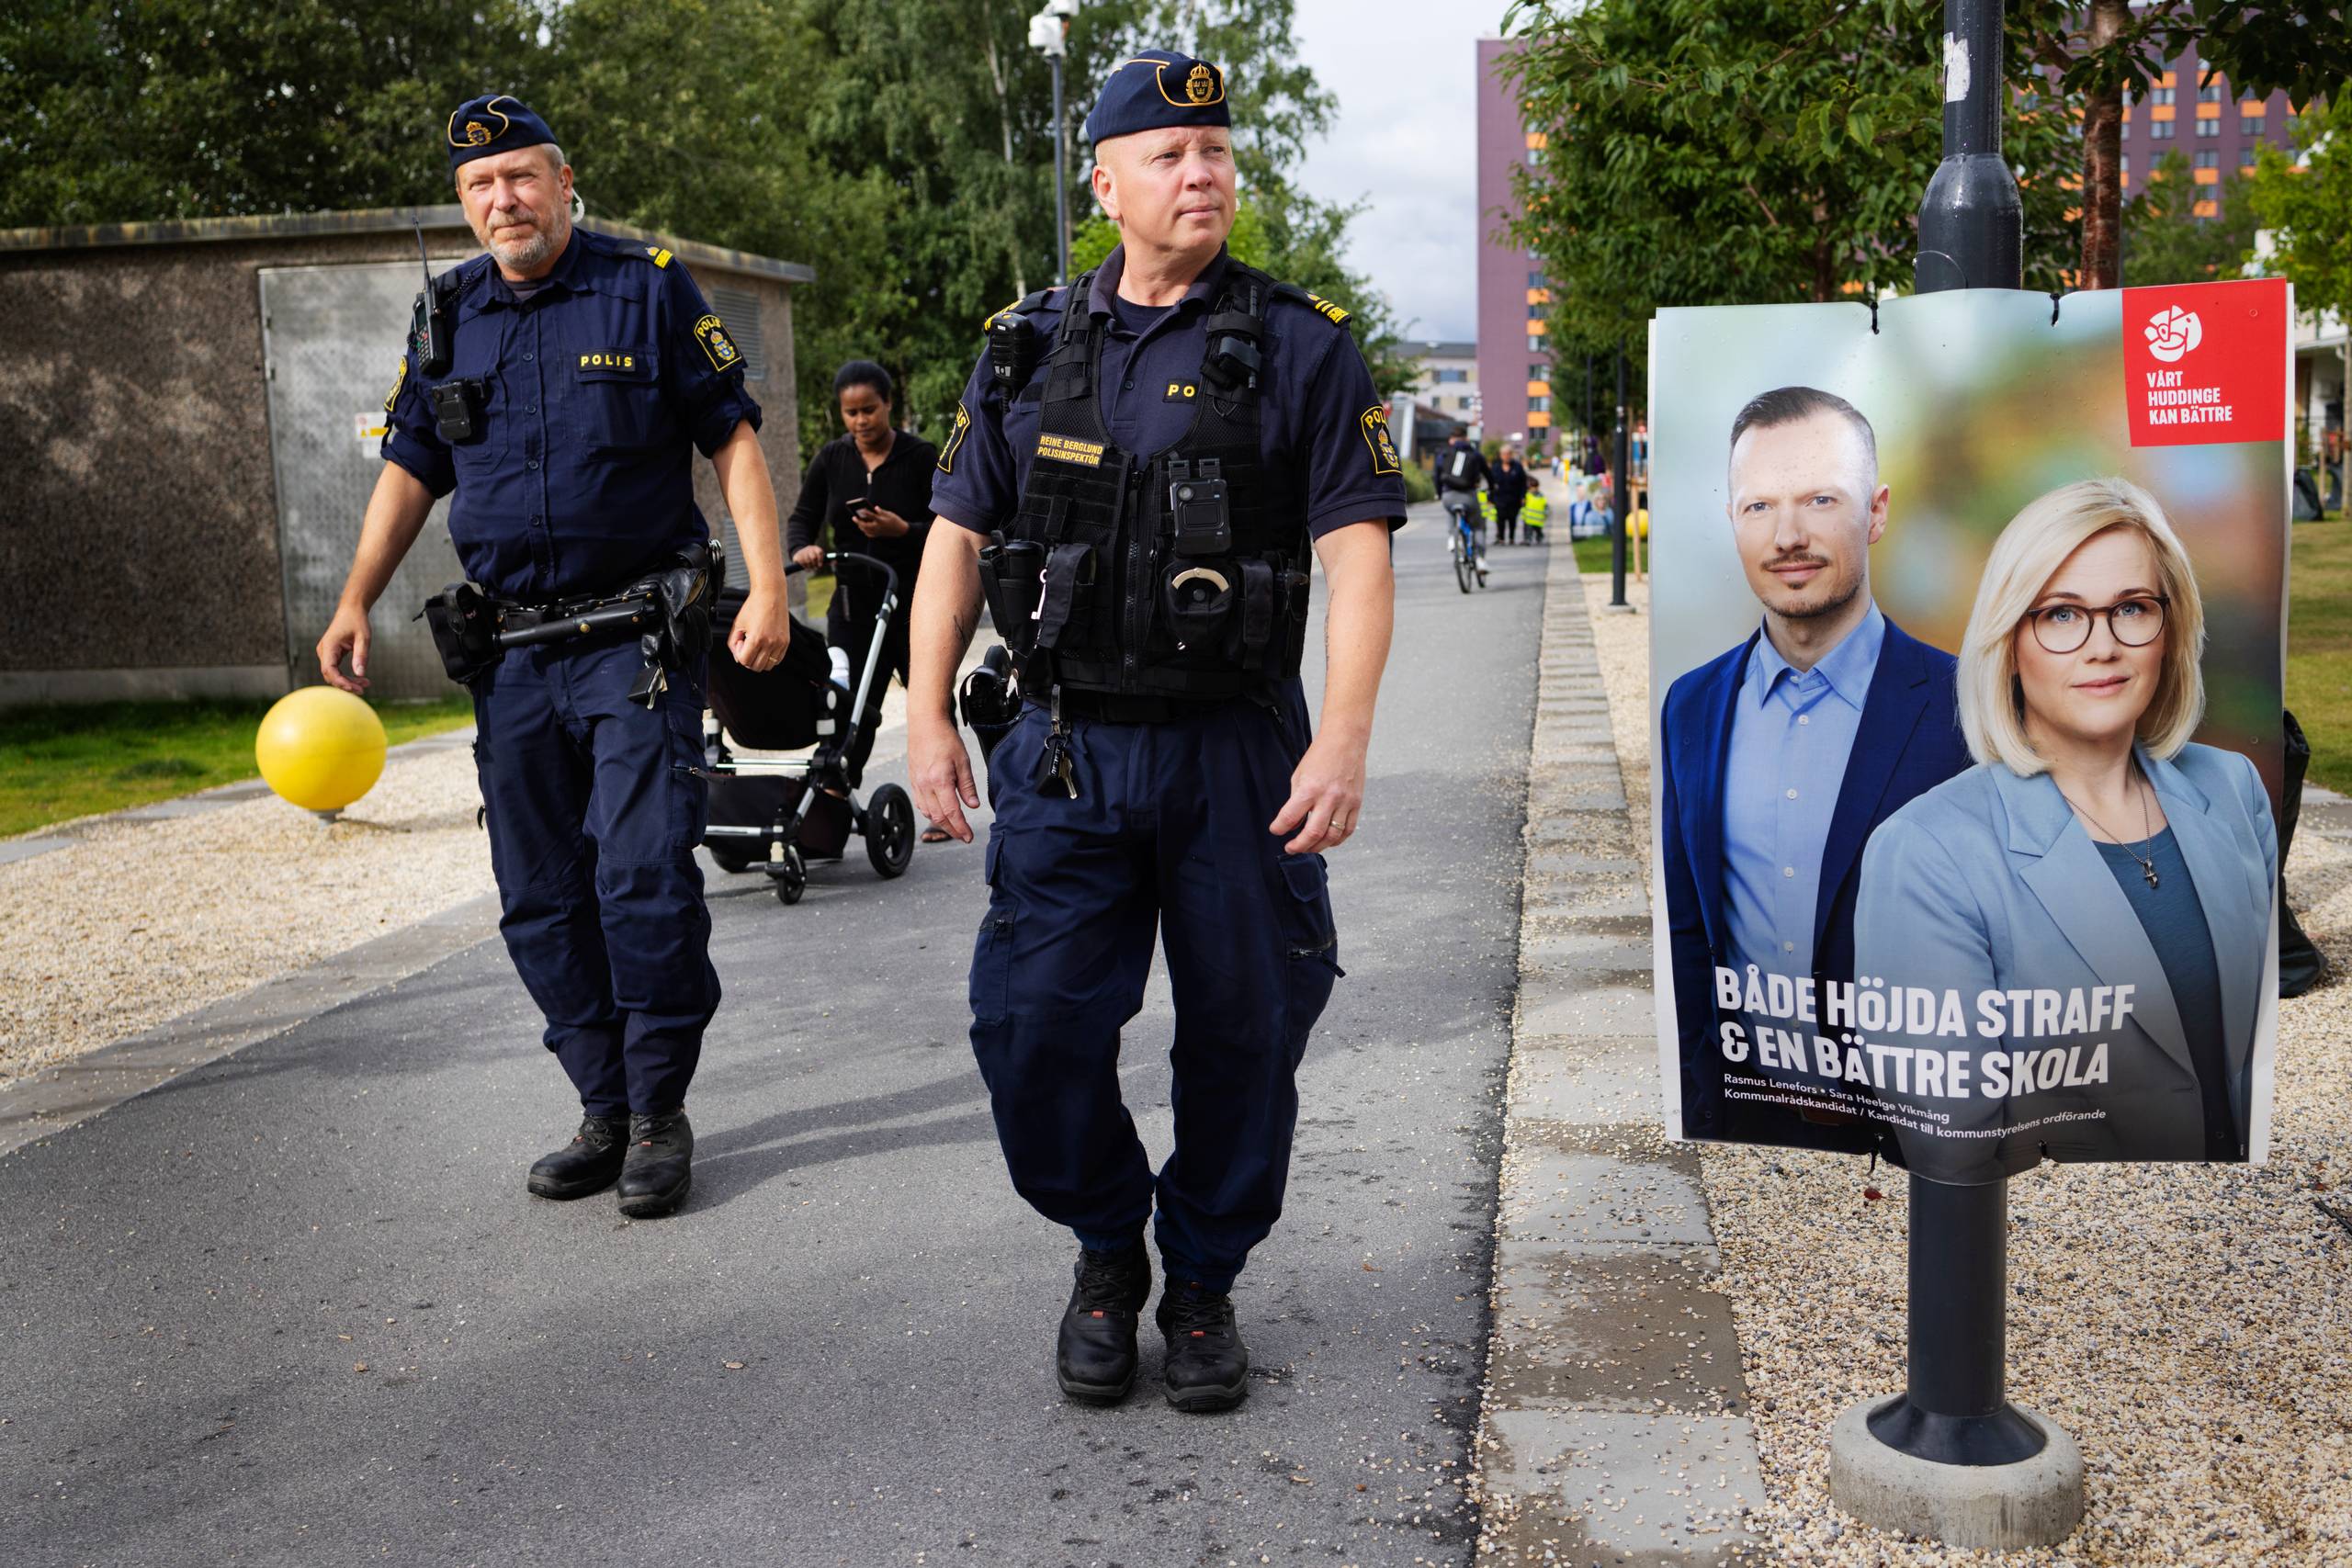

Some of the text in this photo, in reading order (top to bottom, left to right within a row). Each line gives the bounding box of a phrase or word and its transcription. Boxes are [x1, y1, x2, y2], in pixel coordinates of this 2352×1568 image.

[696, 317, 721, 337] POLIS
[581, 355, 632, 367] POLIS
[2146, 370, 2183, 388] VÅRT
[2148, 388, 2221, 406] HUDDINGE
[2149, 405, 2233, 425] KAN BÄTTRE
[1040, 435, 1103, 455] REINE BERGLUND
[1037, 446, 1100, 465] POLISINSPEKTÖR
[1714, 964, 2136, 1038] BÅDE HÖJDA STRAFF
[1720, 1021, 2109, 1100] & EN BÄTTRE SKOLA
[1724, 1073, 1767, 1087] Rasmus
[1770, 1078, 1817, 1094] Lenefors
[1829, 1088, 1854, 1101] Sara
[1897, 1103, 1951, 1124] Vikmång
[1724, 1089, 1858, 1115] Kommunalrådskandidat
[1868, 1109, 1918, 1129] Kandidat
[1920, 1122, 1934, 1134] till
[1936, 1119, 2041, 1139] kommunstyrelsens
[2042, 1109, 2107, 1124] ordförande
